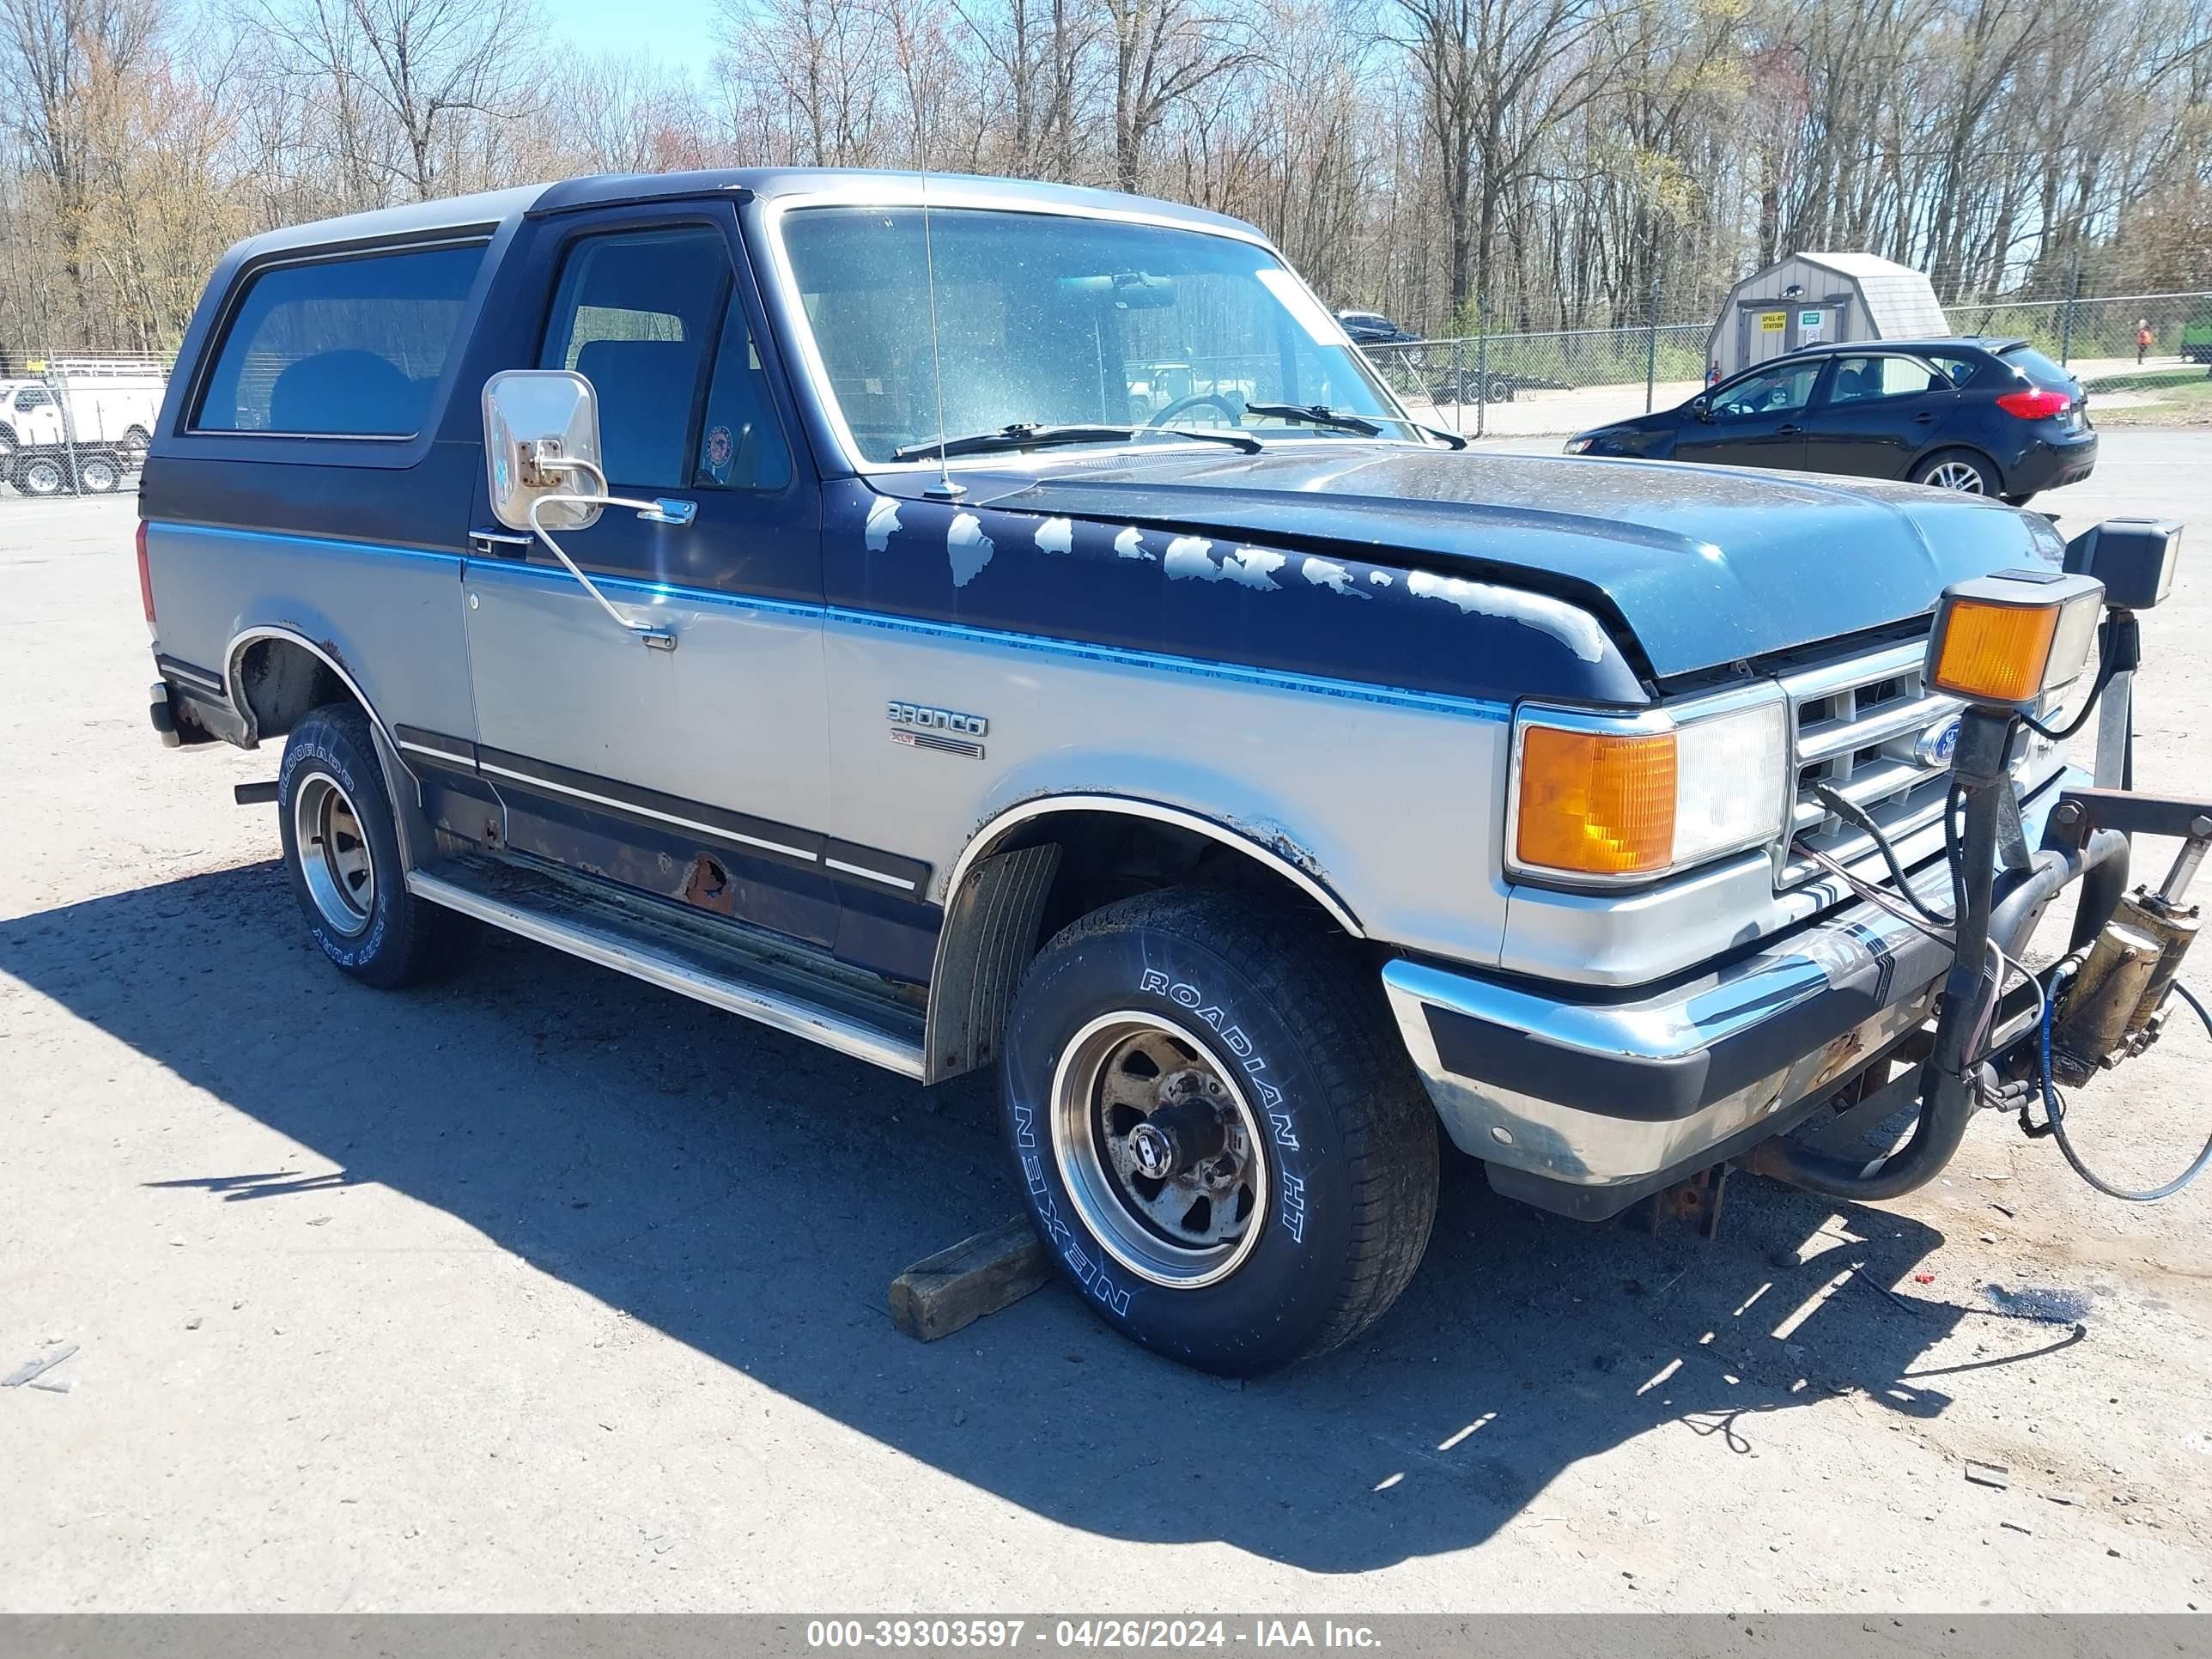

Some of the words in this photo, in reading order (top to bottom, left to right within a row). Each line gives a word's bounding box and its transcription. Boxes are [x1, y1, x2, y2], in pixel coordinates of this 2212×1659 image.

[886, 701, 988, 737] BRONCO
[892, 732, 914, 744] XLT
[279, 744, 355, 806] ELDORADO
[312, 928, 354, 967] FURY
[1140, 967, 1300, 1150] ROADIAN
[1283, 1171, 1306, 1244] HT
[1015, 1106, 1131, 1318] NEXEN
